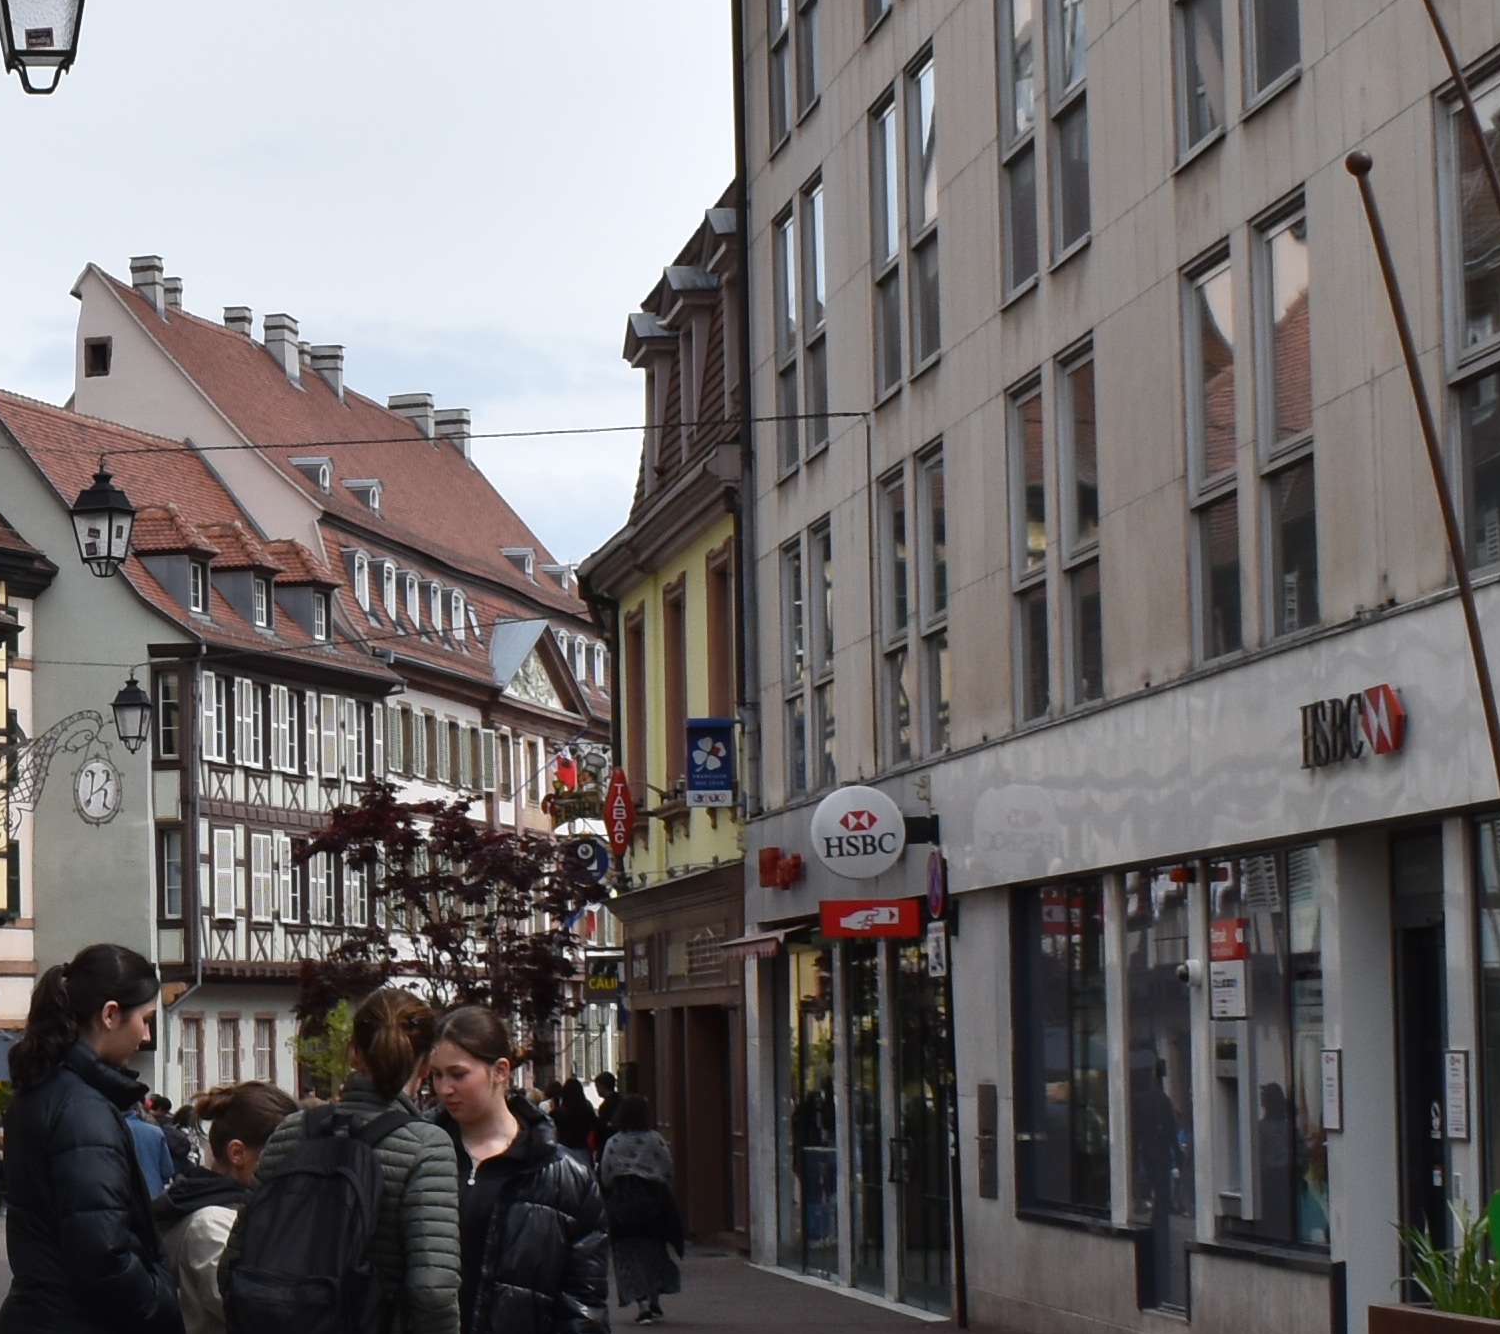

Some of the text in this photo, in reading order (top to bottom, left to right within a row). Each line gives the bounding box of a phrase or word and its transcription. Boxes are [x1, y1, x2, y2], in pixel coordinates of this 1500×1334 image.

[1299, 692, 1365, 770] HSBC
[612, 783, 627, 845] TABAC
[823, 832, 897, 859] HSBC
